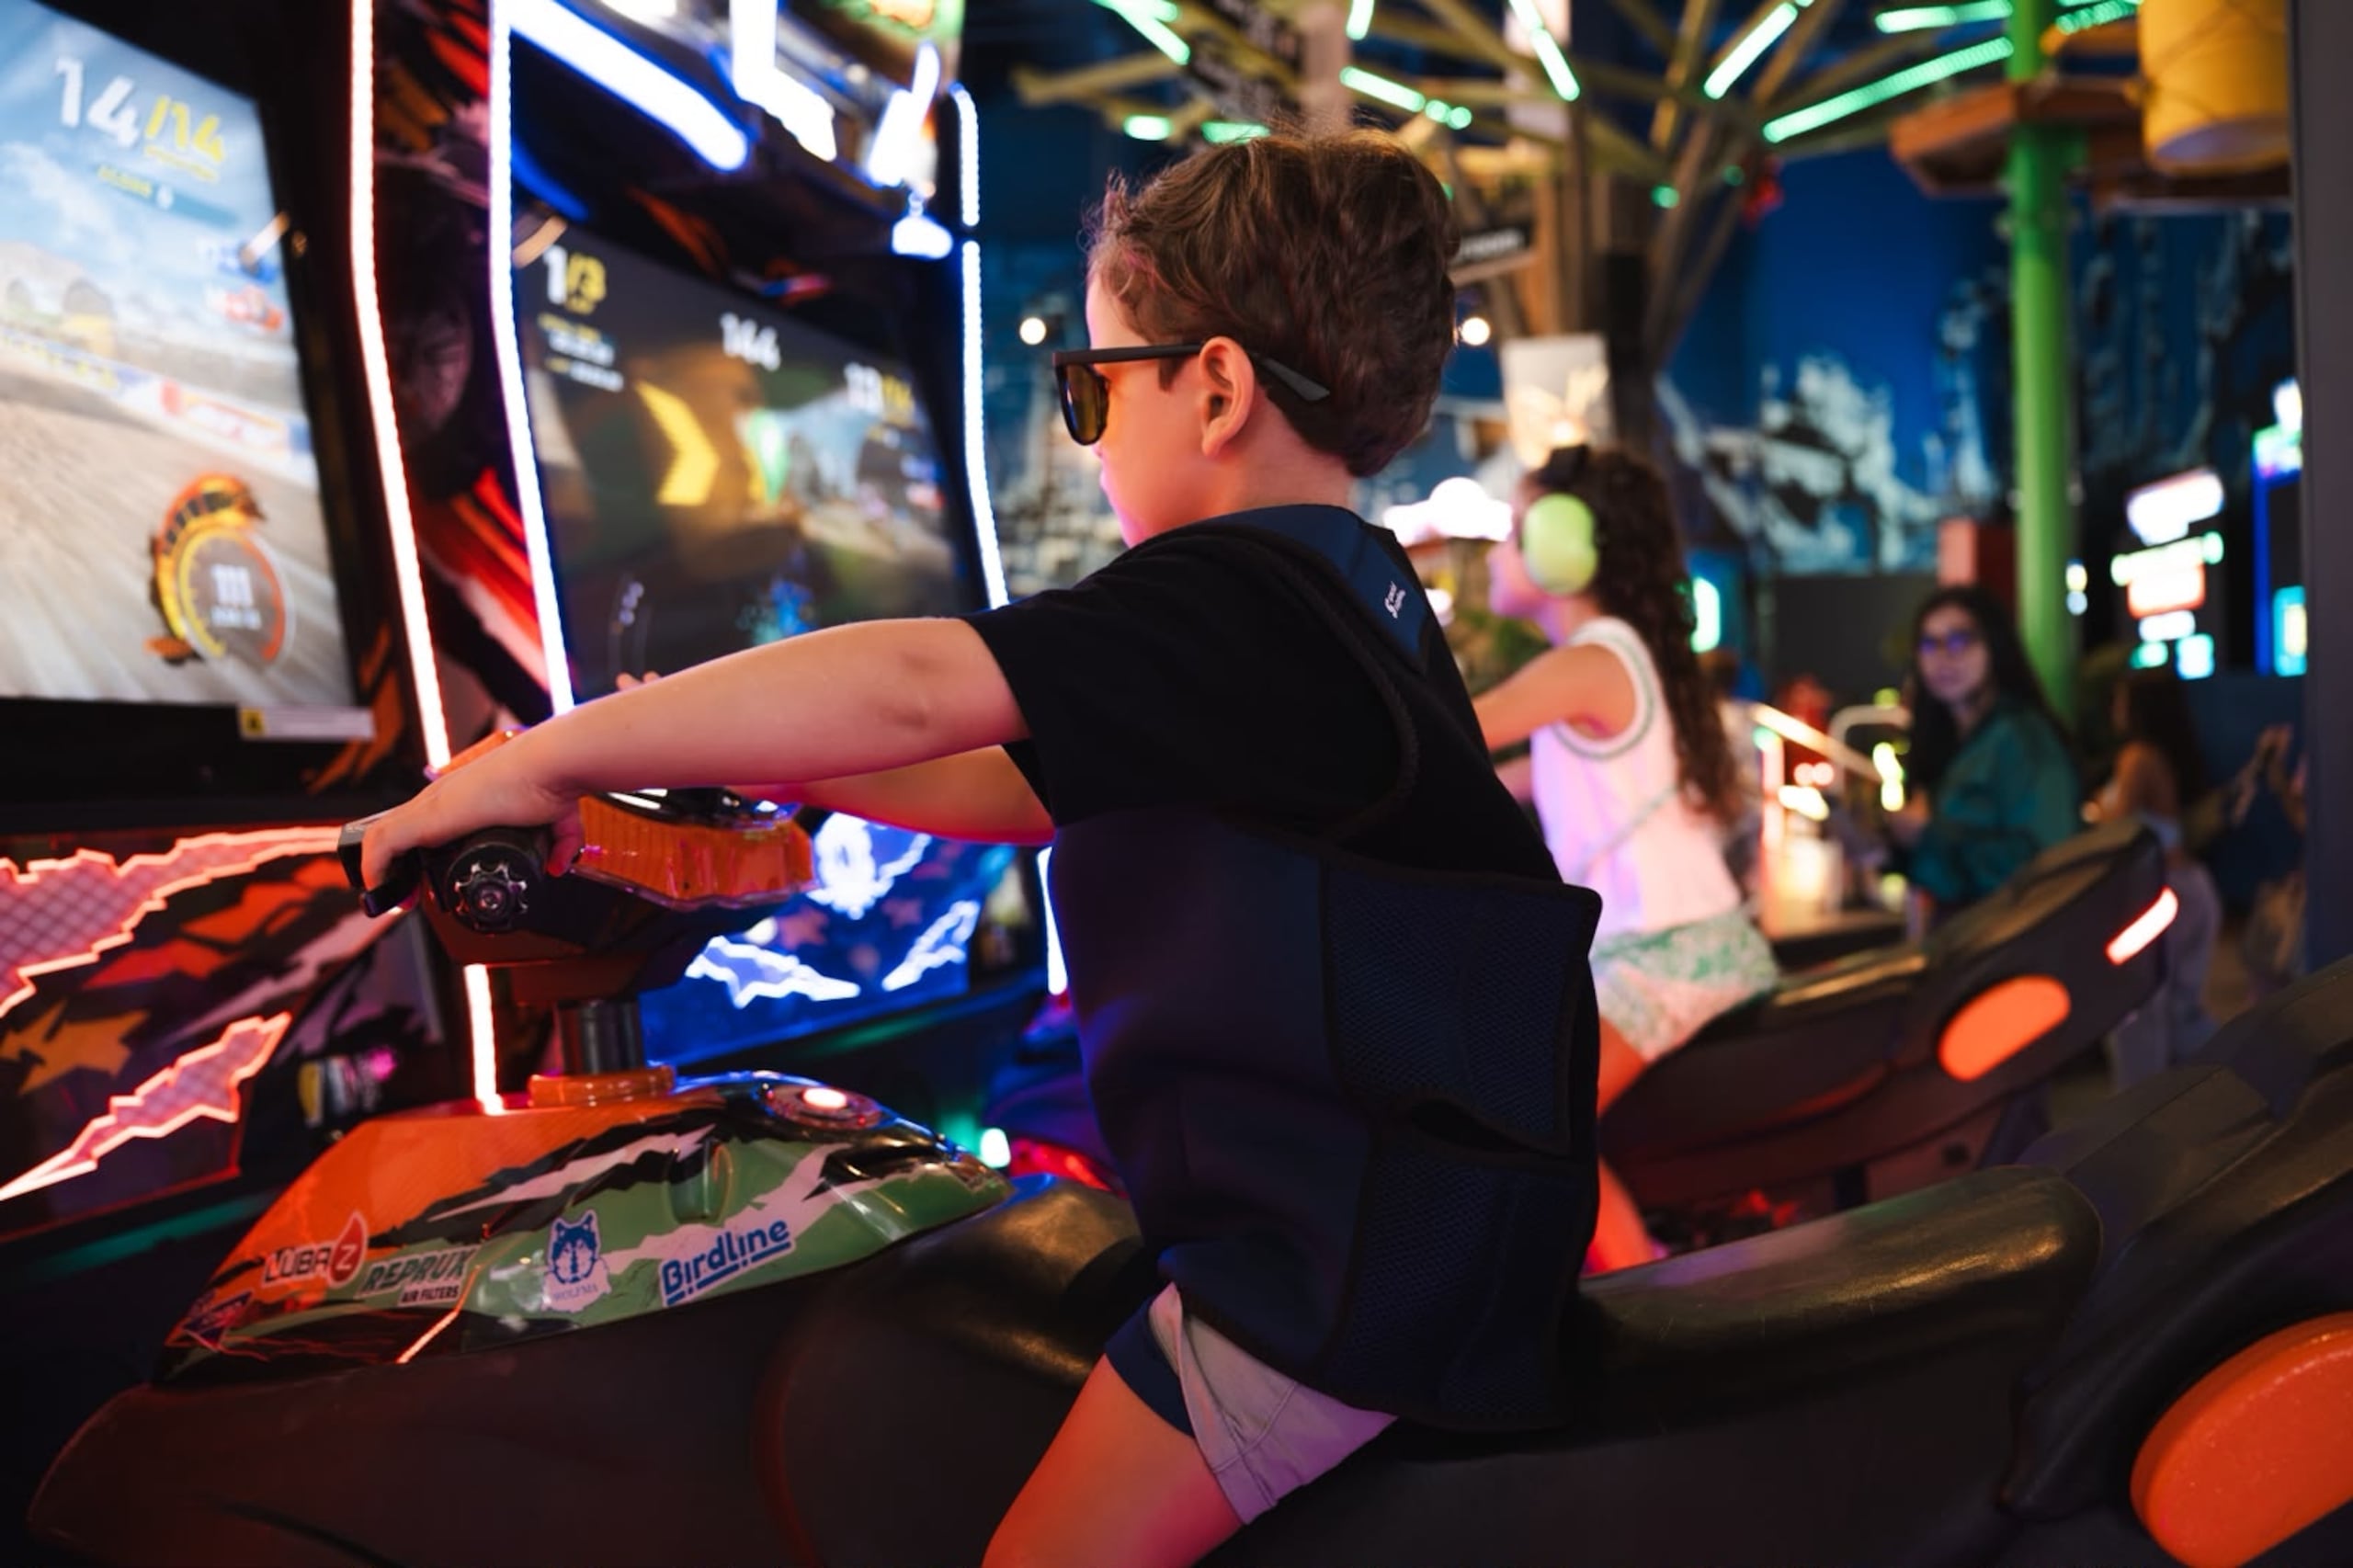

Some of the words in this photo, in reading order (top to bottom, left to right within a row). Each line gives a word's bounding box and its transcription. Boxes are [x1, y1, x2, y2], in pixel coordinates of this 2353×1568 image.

[56, 56, 224, 164] 14/14
[400, 1289, 419, 1302] AIR
[421, 1285, 459, 1301] FILTERS
[661, 1220, 791, 1298] Birdline
